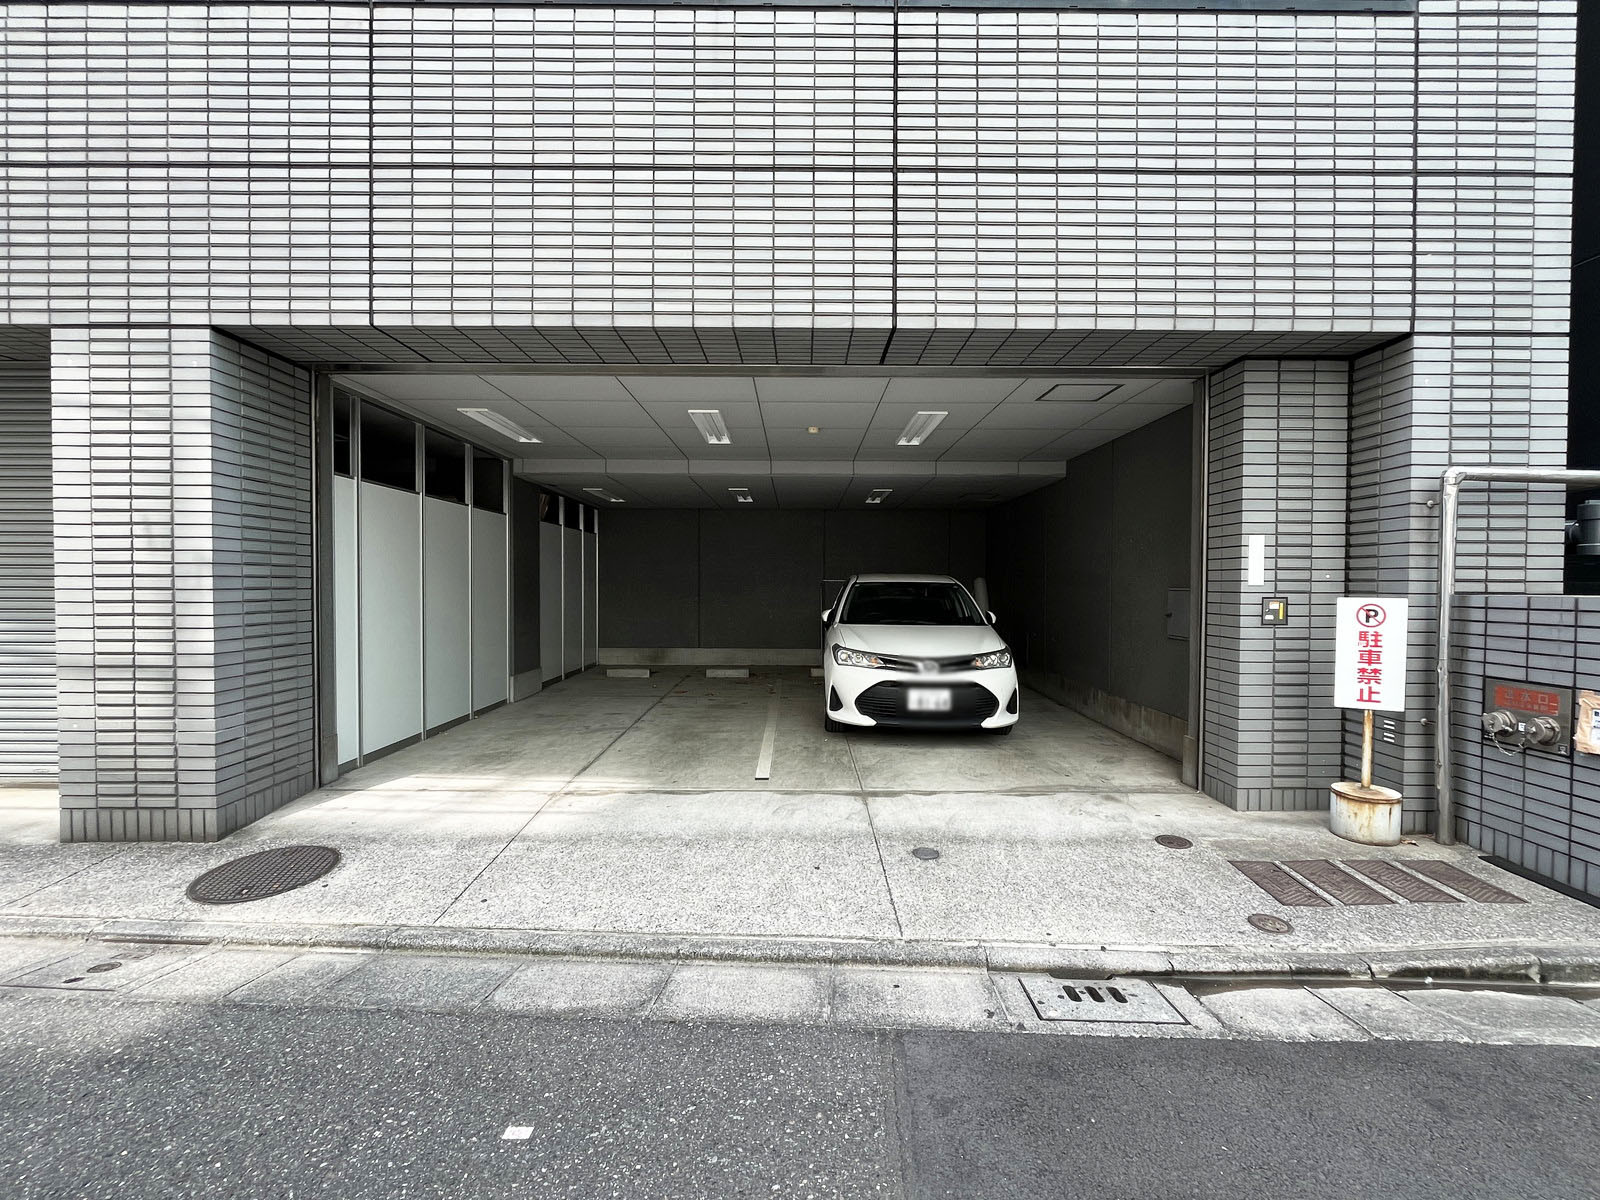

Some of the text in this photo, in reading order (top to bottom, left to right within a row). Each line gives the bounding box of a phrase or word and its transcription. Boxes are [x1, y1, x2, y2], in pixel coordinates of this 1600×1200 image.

[1365, 608, 1379, 623] P
[1357, 630, 1383, 703] 駐車禁止
